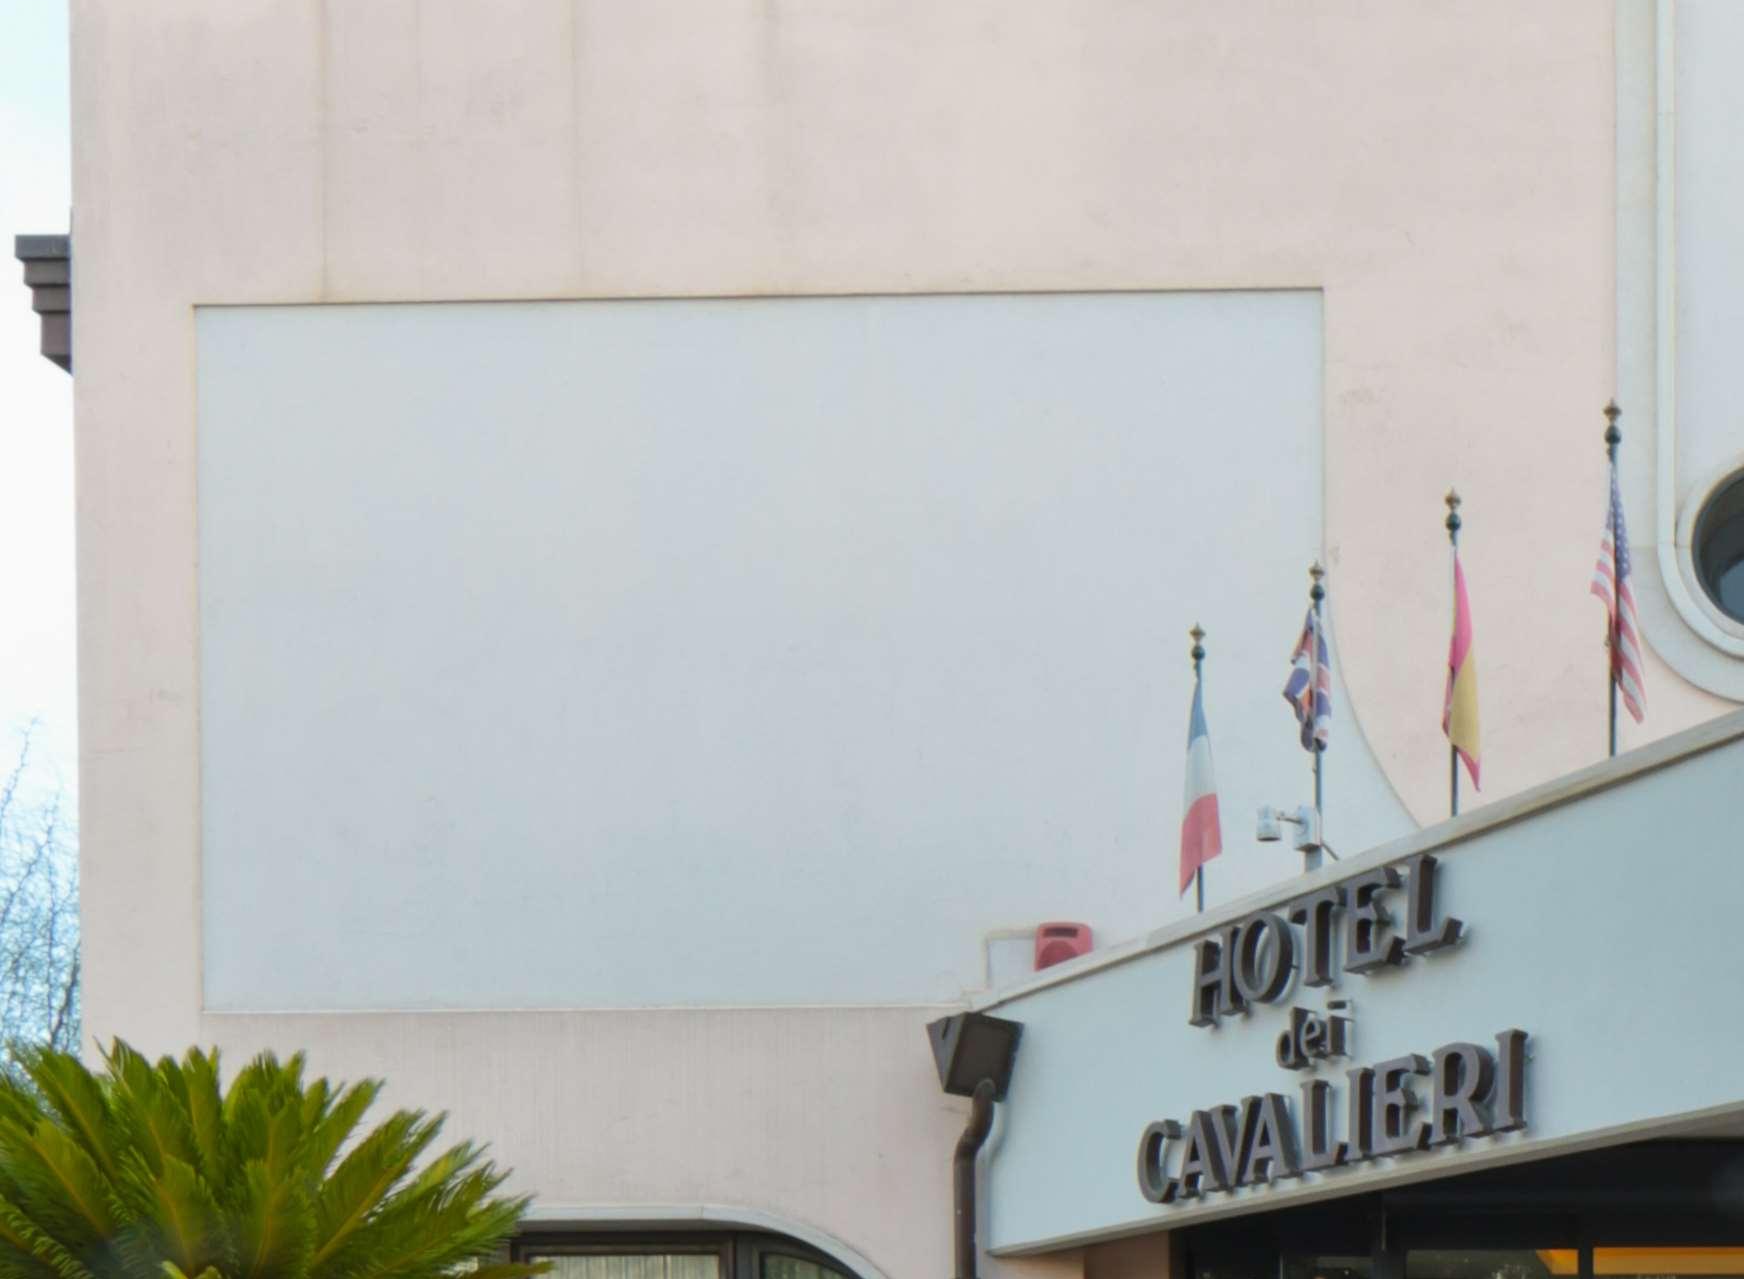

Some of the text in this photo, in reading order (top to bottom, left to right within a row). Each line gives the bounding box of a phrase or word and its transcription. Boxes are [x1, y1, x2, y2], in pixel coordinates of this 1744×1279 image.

[1188, 853, 1463, 1028] HOTEL
[1136, 1028, 1530, 1204] CAVALIERI
[1275, 999, 1349, 1071] dei
